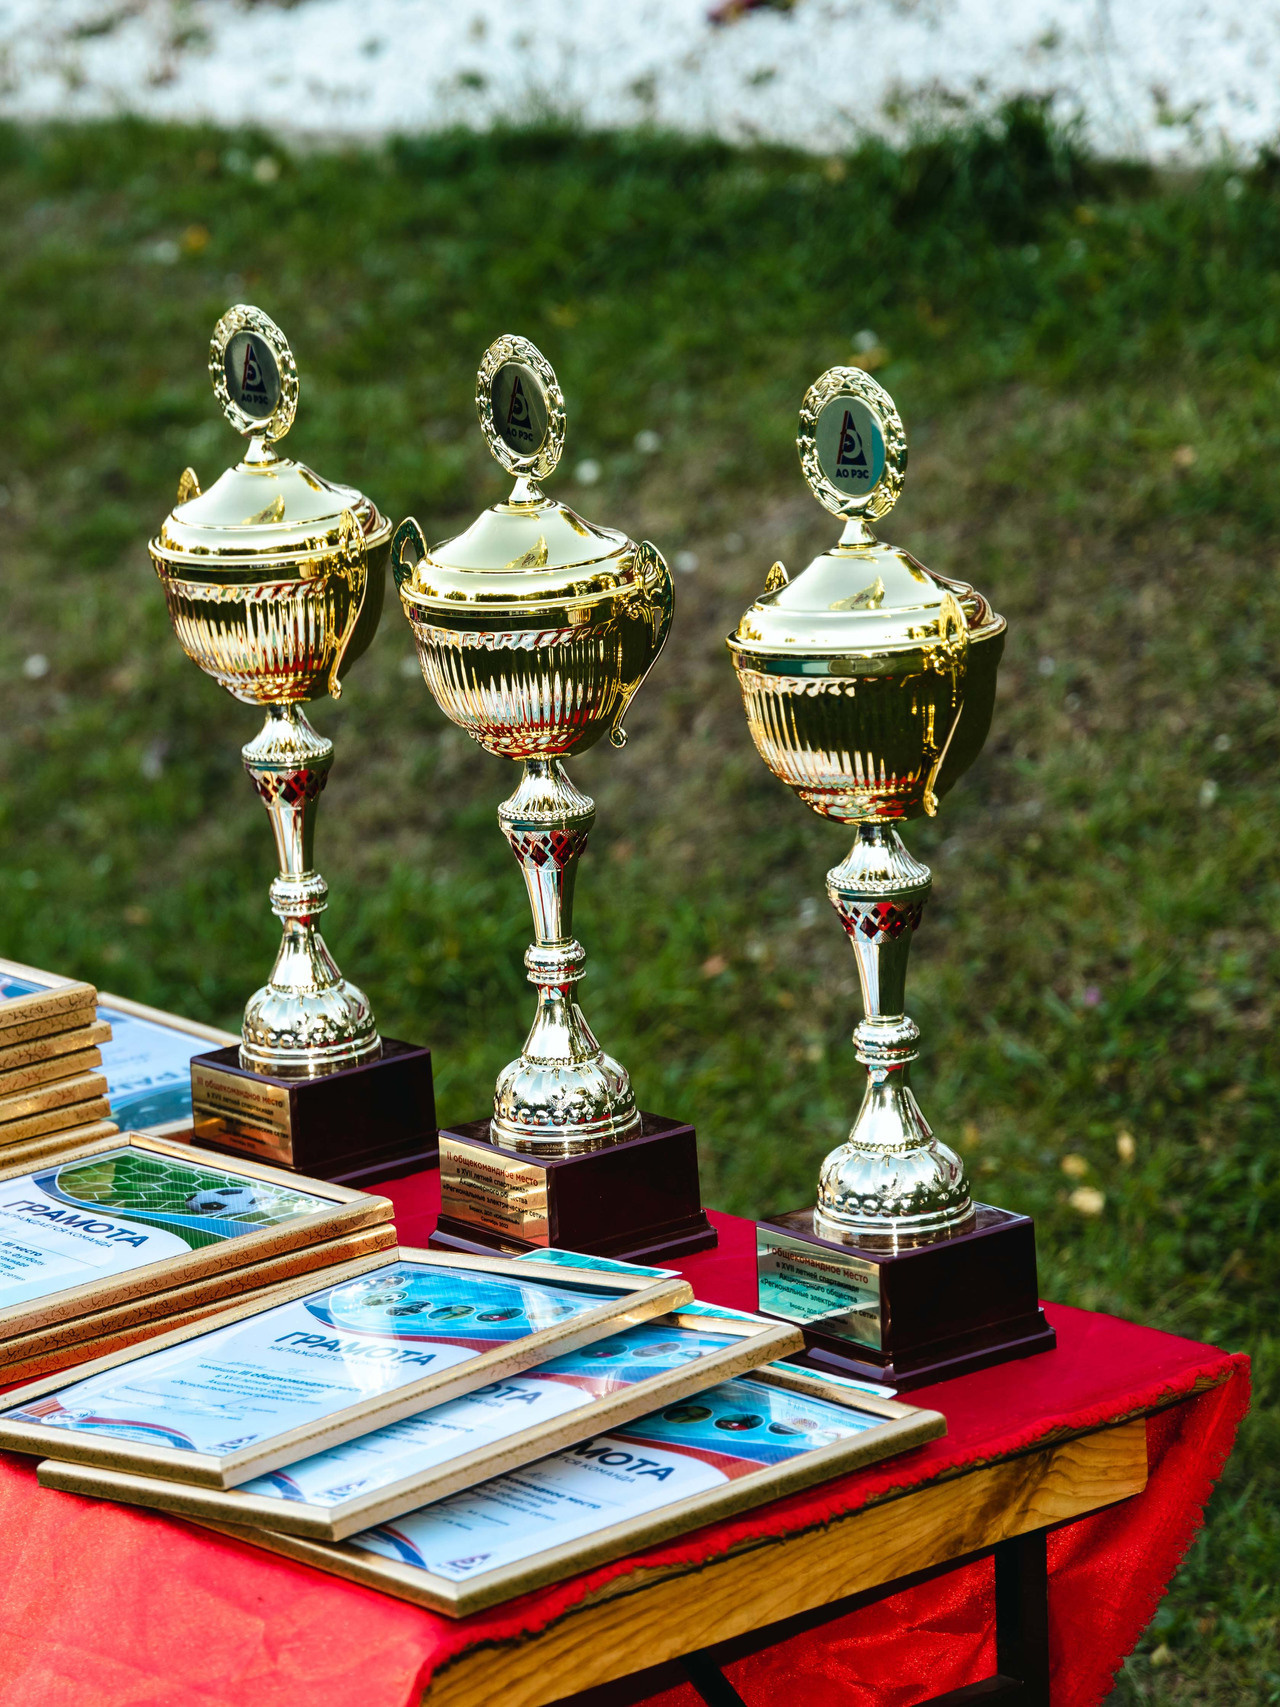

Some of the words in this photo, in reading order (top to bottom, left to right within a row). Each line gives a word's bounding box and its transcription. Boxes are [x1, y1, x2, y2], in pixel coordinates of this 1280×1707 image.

[241, 394, 252, 402] АО
[253, 395, 268, 405] РЭС
[506, 428, 517, 437] АО
[519, 430, 533, 441] РЭС
[836, 468, 850, 478] АО
[851, 469, 869, 479] РЭС
[205, 1080, 261, 1102] общекомандное
[262, 1097, 283, 1108] место
[446, 1151, 452, 1160] II
[453, 1155, 514, 1180] общекомандное
[515, 1174, 538, 1186] место
[461, 1168, 473, 1177] XVII
[473, 1173, 492, 1183] летней
[459, 1178, 499, 1196] Акционерного
[2, 1200, 149, 1247] ГРАМОТА
[67, 1232, 112, 1248] КОМАНДА
[13, 1246, 42, 1256] место
[771, 1245, 840, 1275] общекомандное
[843, 1270, 868, 1284] место
[781, 1262, 794, 1272] XVII
[795, 1268, 817, 1280] летней
[819, 1276, 859, 1293] спартакиаде
[780, 1273, 824, 1292] Акционерного
[826, 1288, 858, 1303] общества
[761, 1278, 808, 1298] «Региональные
[858, 1310, 877, 1320] сети»
[274, 1331, 436, 1366] ГРАМОТА
[251, 1373, 334, 1388] общекомандное
[565, 1439, 674, 1480] МОТА
[581, 1464, 635, 1483] КОМАНДА
[566, 1497, 601, 1509] место
